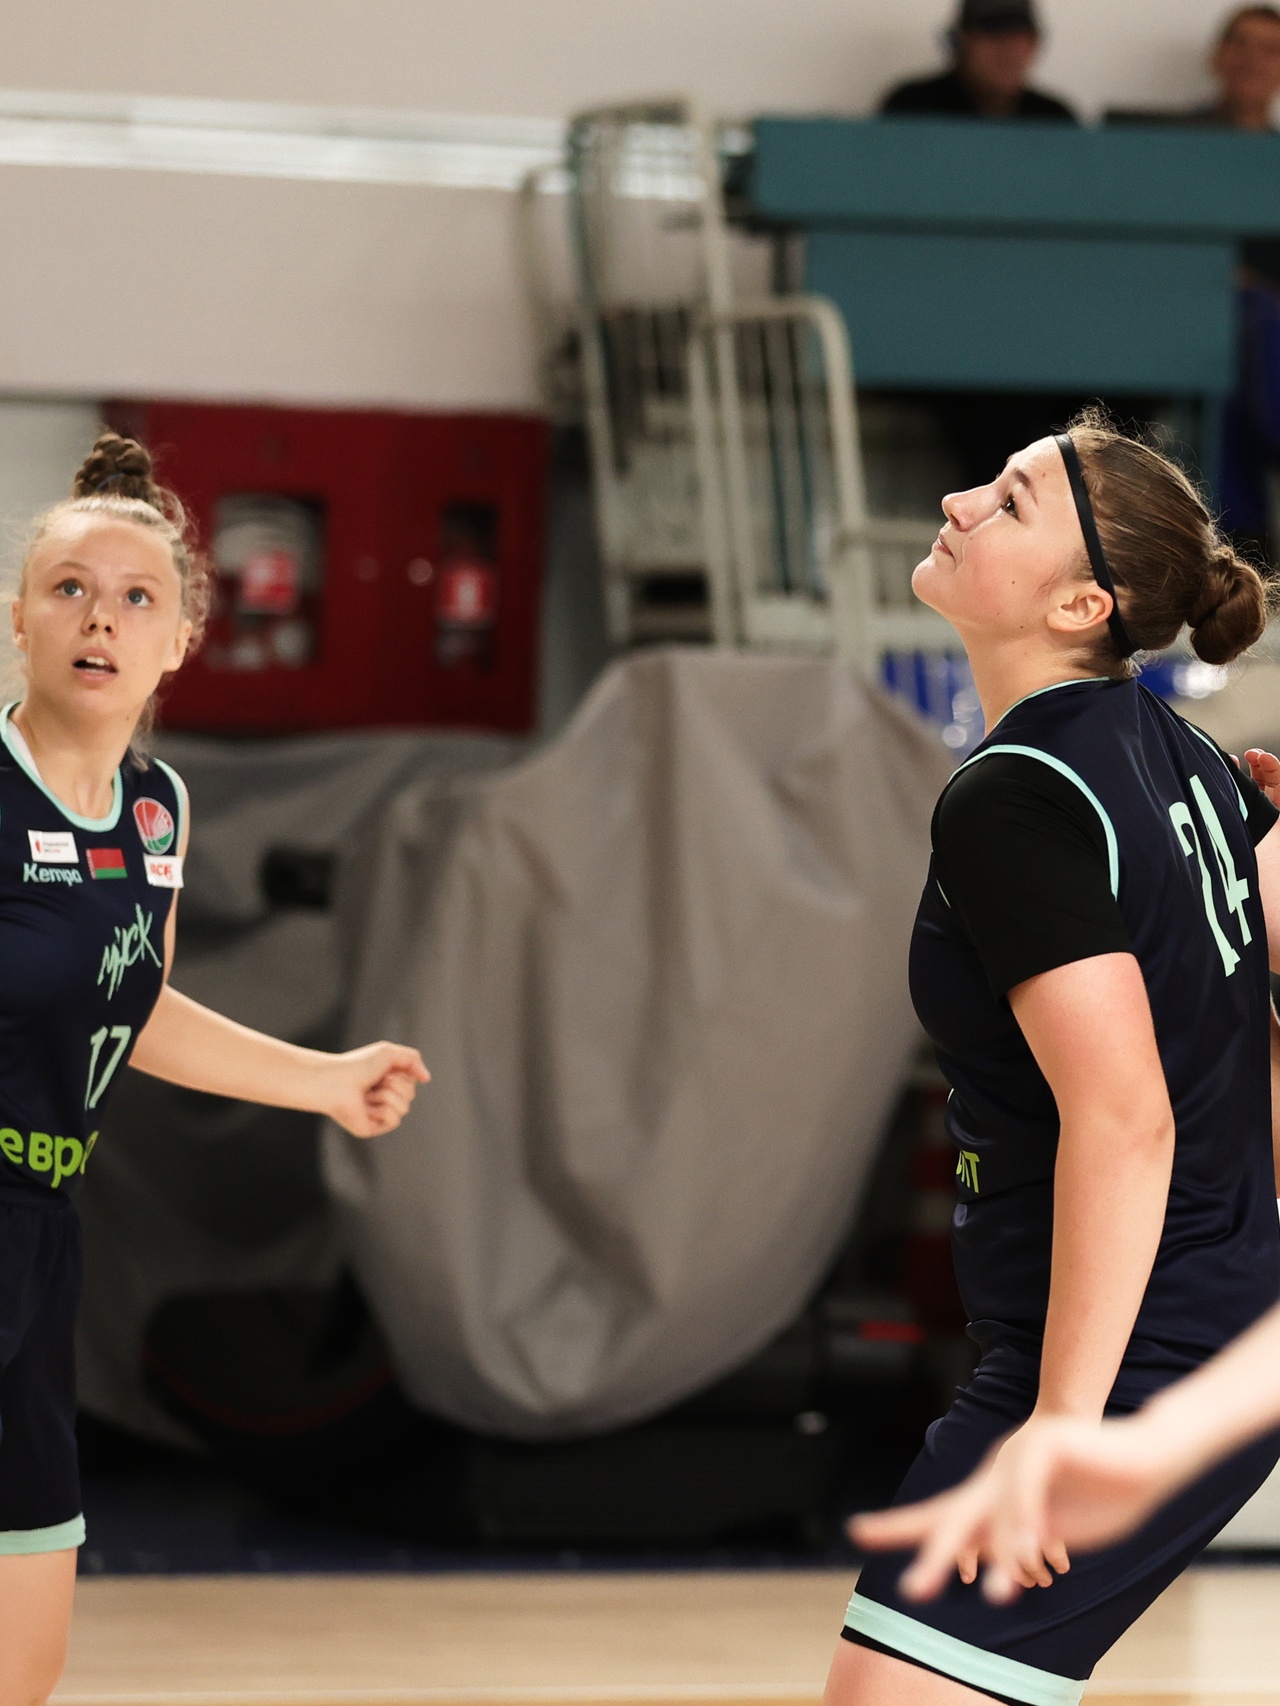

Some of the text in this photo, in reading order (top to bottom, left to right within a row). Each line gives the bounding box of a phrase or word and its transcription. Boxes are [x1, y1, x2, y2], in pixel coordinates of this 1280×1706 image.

[23, 862, 83, 887] Kempa
[1169, 775, 1252, 977] 24
[84, 1025, 132, 1111] 17
